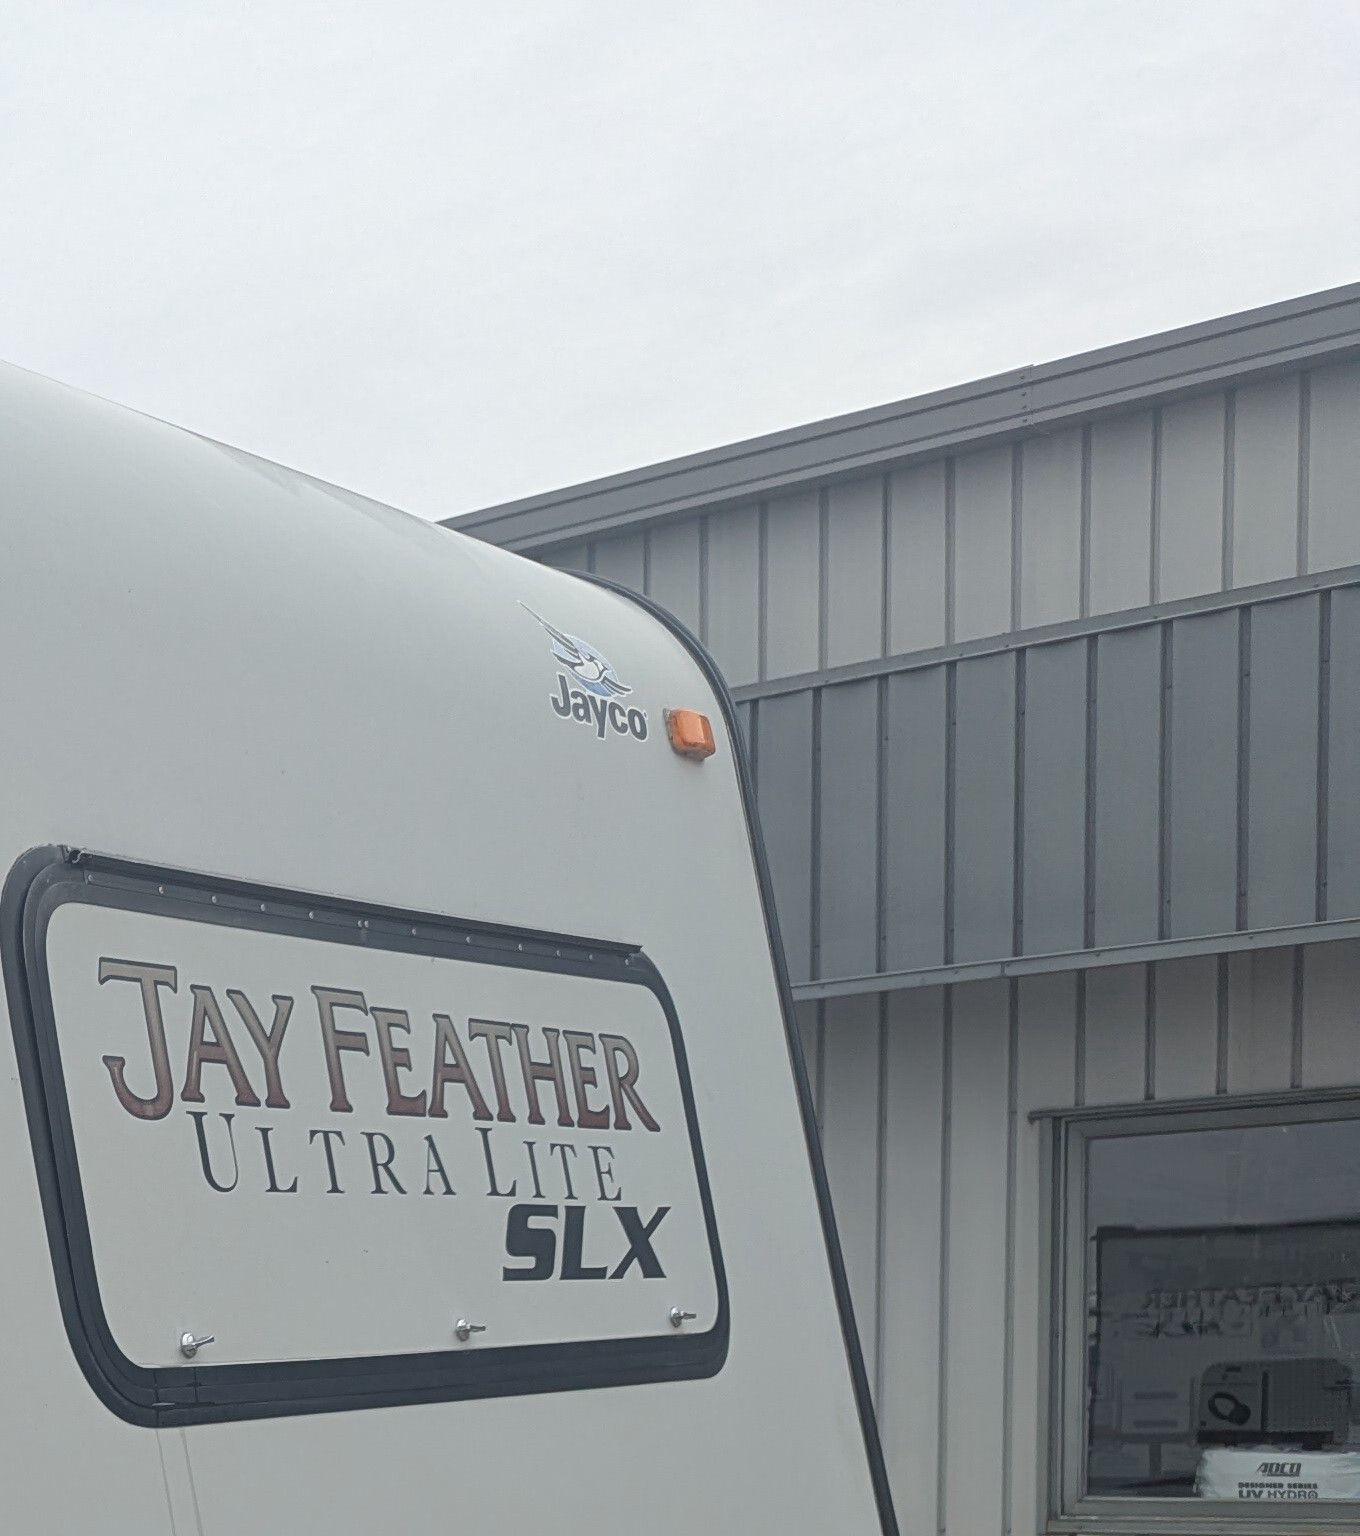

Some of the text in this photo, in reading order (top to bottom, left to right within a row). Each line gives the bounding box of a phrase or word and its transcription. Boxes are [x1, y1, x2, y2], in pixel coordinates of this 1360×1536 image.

[550, 673, 648, 741] Jayco
[98, 956, 661, 1133] JAY FEATHER
[185, 1109, 623, 1201] ULTRA LITE
[502, 1203, 673, 1282] SLX
[1238, 1490, 1319, 1499] UV HYDRO
[1254, 1462, 1302, 1477] ADCO
